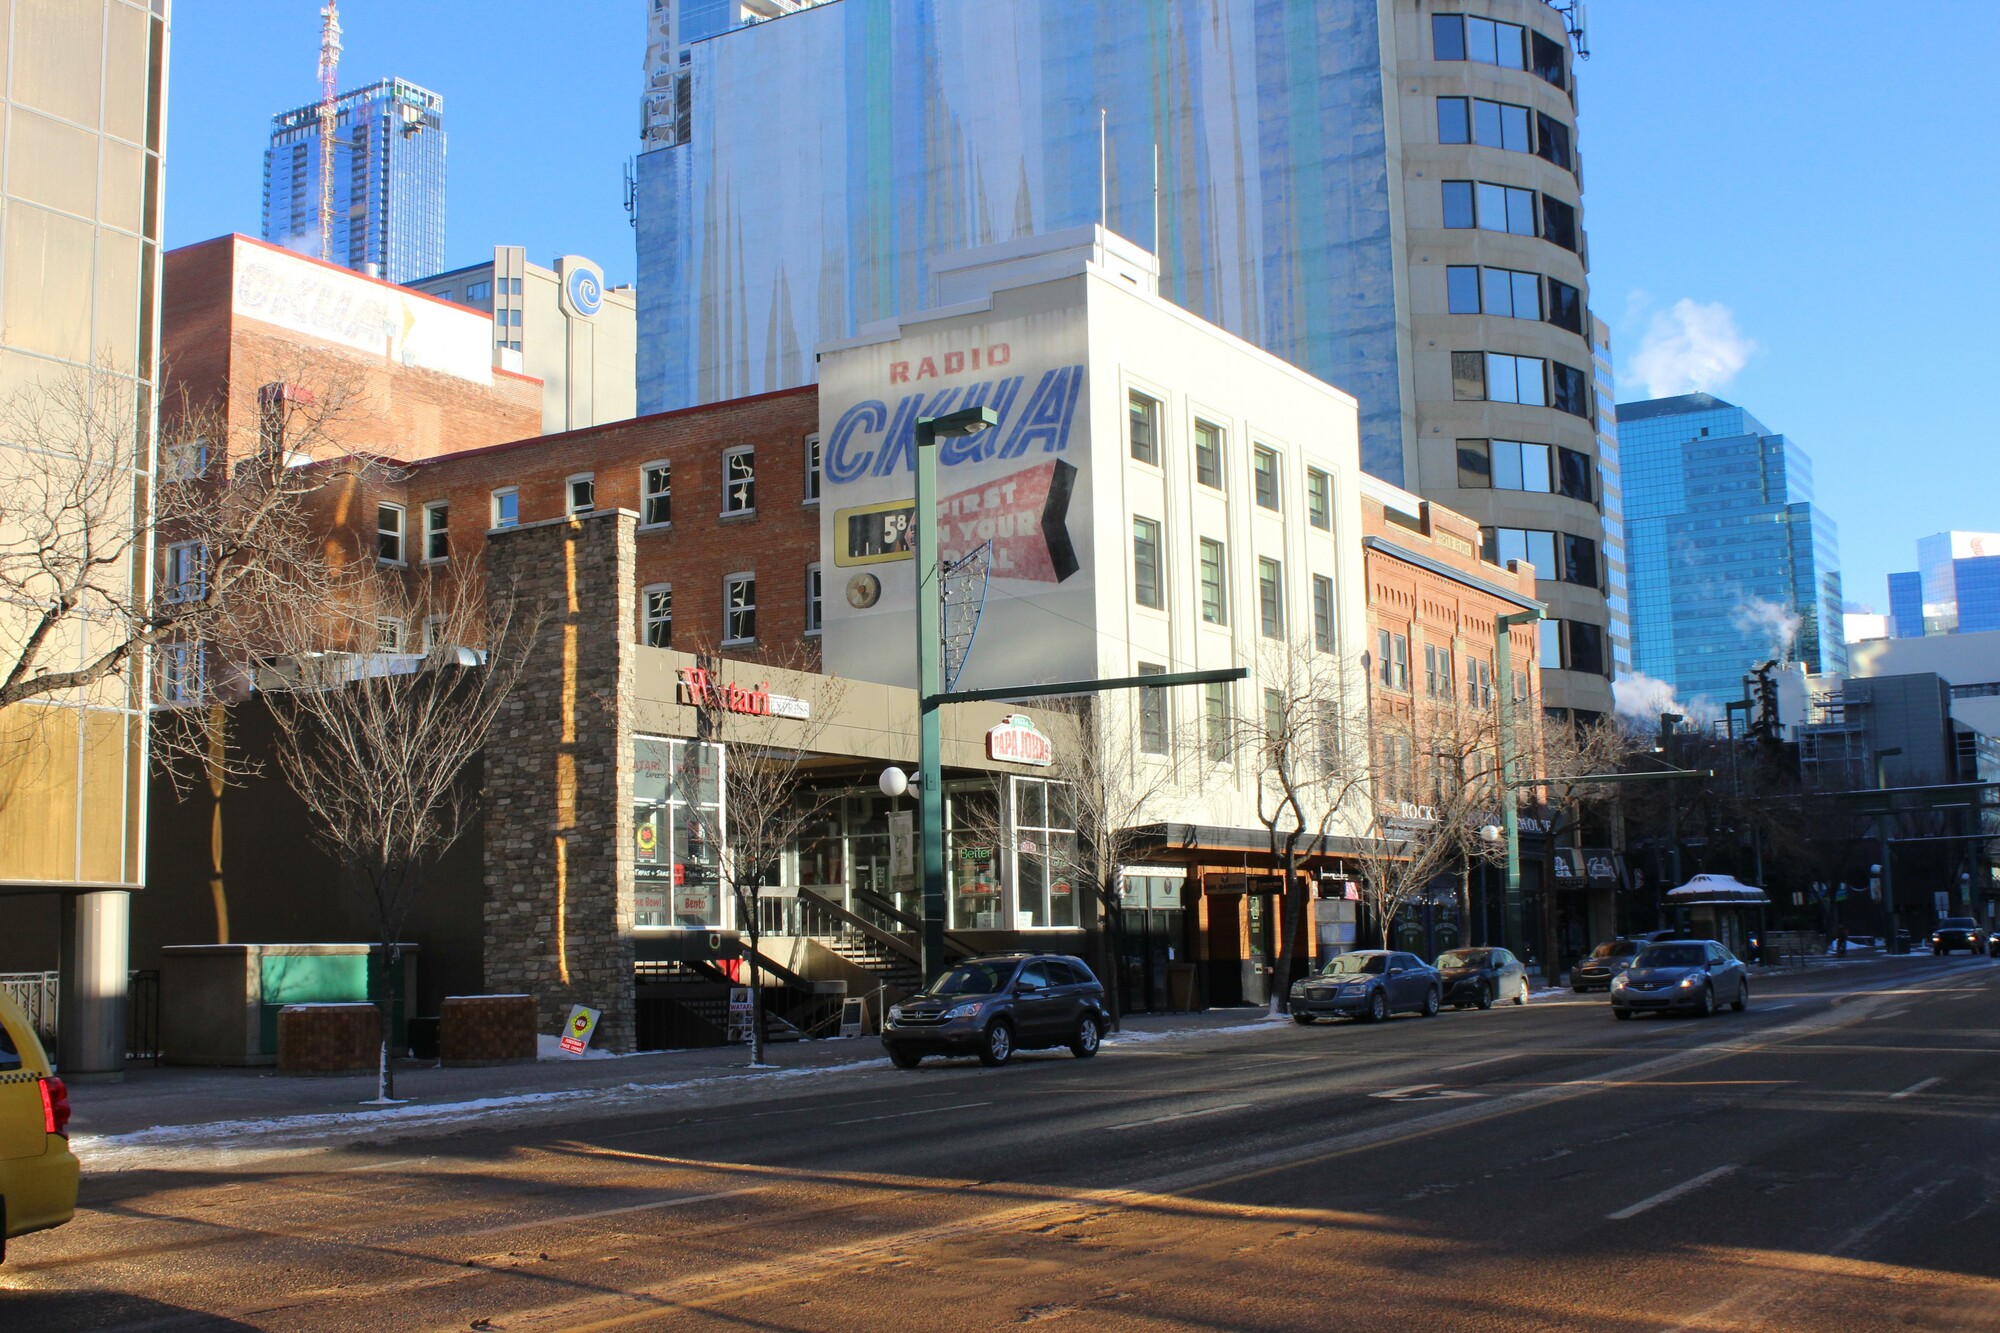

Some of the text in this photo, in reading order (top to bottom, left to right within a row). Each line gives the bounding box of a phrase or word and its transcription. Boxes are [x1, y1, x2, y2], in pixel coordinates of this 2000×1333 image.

[889, 343, 1011, 385] RADIO
[825, 364, 1084, 485] CKUA
[937, 482, 1017, 519] FIRST
[957, 510, 1038, 542] YOUR
[994, 730, 1018, 756] PAPA
[960, 847, 993, 859] Better
[685, 897, 706, 909] Bento
